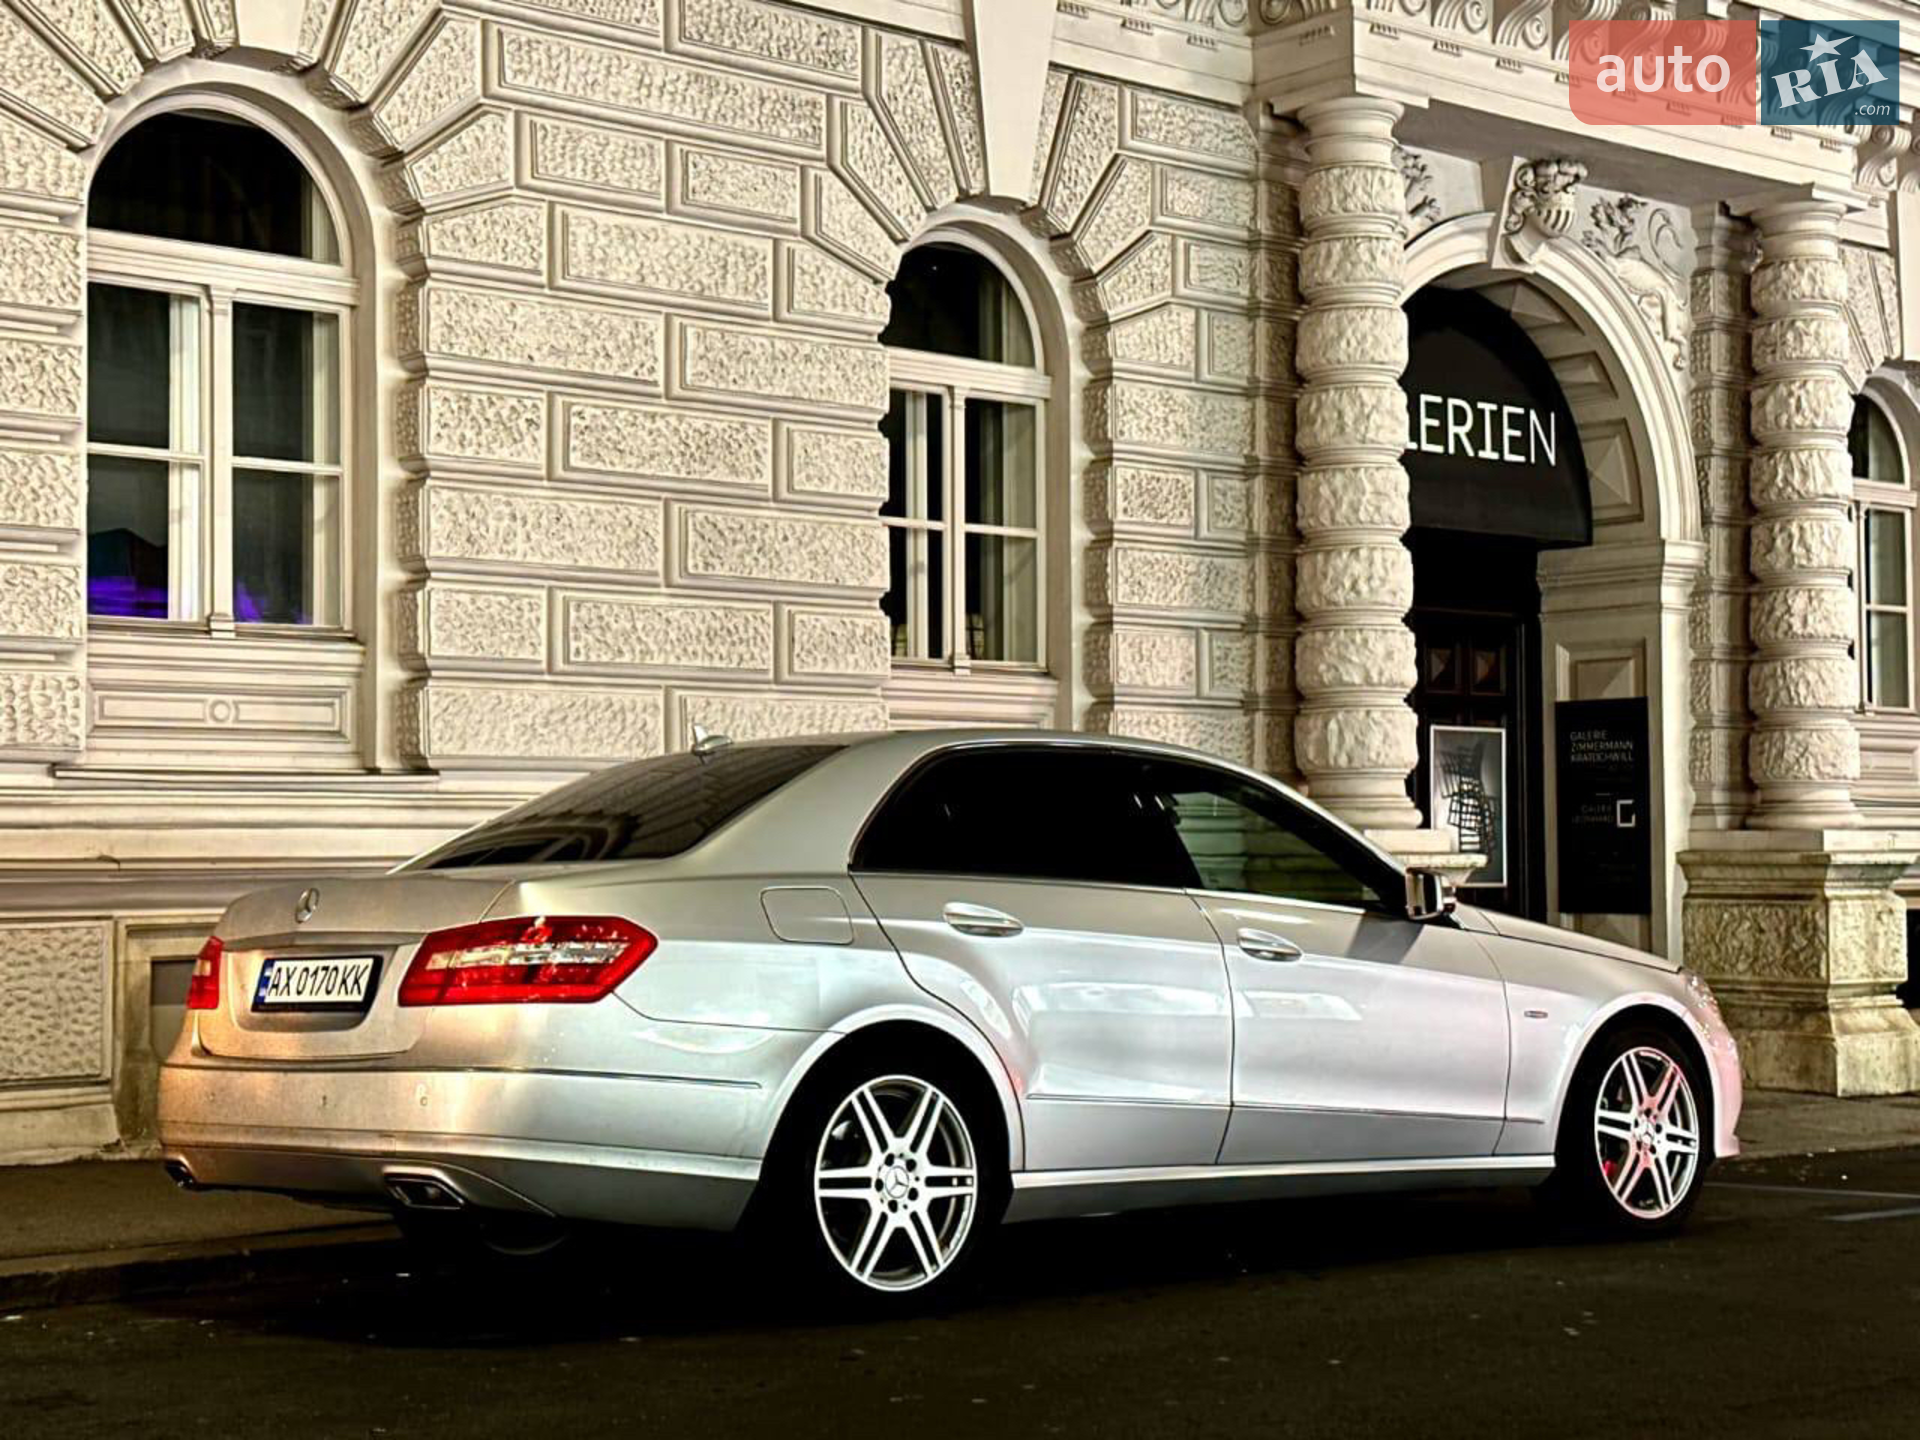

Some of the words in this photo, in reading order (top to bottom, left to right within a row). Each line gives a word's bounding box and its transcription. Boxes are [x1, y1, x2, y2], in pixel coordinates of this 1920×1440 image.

[1570, 729, 1608, 741] GALERIE
[268, 966, 297, 996] AX
[296, 965, 339, 996] 0170
[338, 964, 369, 995] KK
